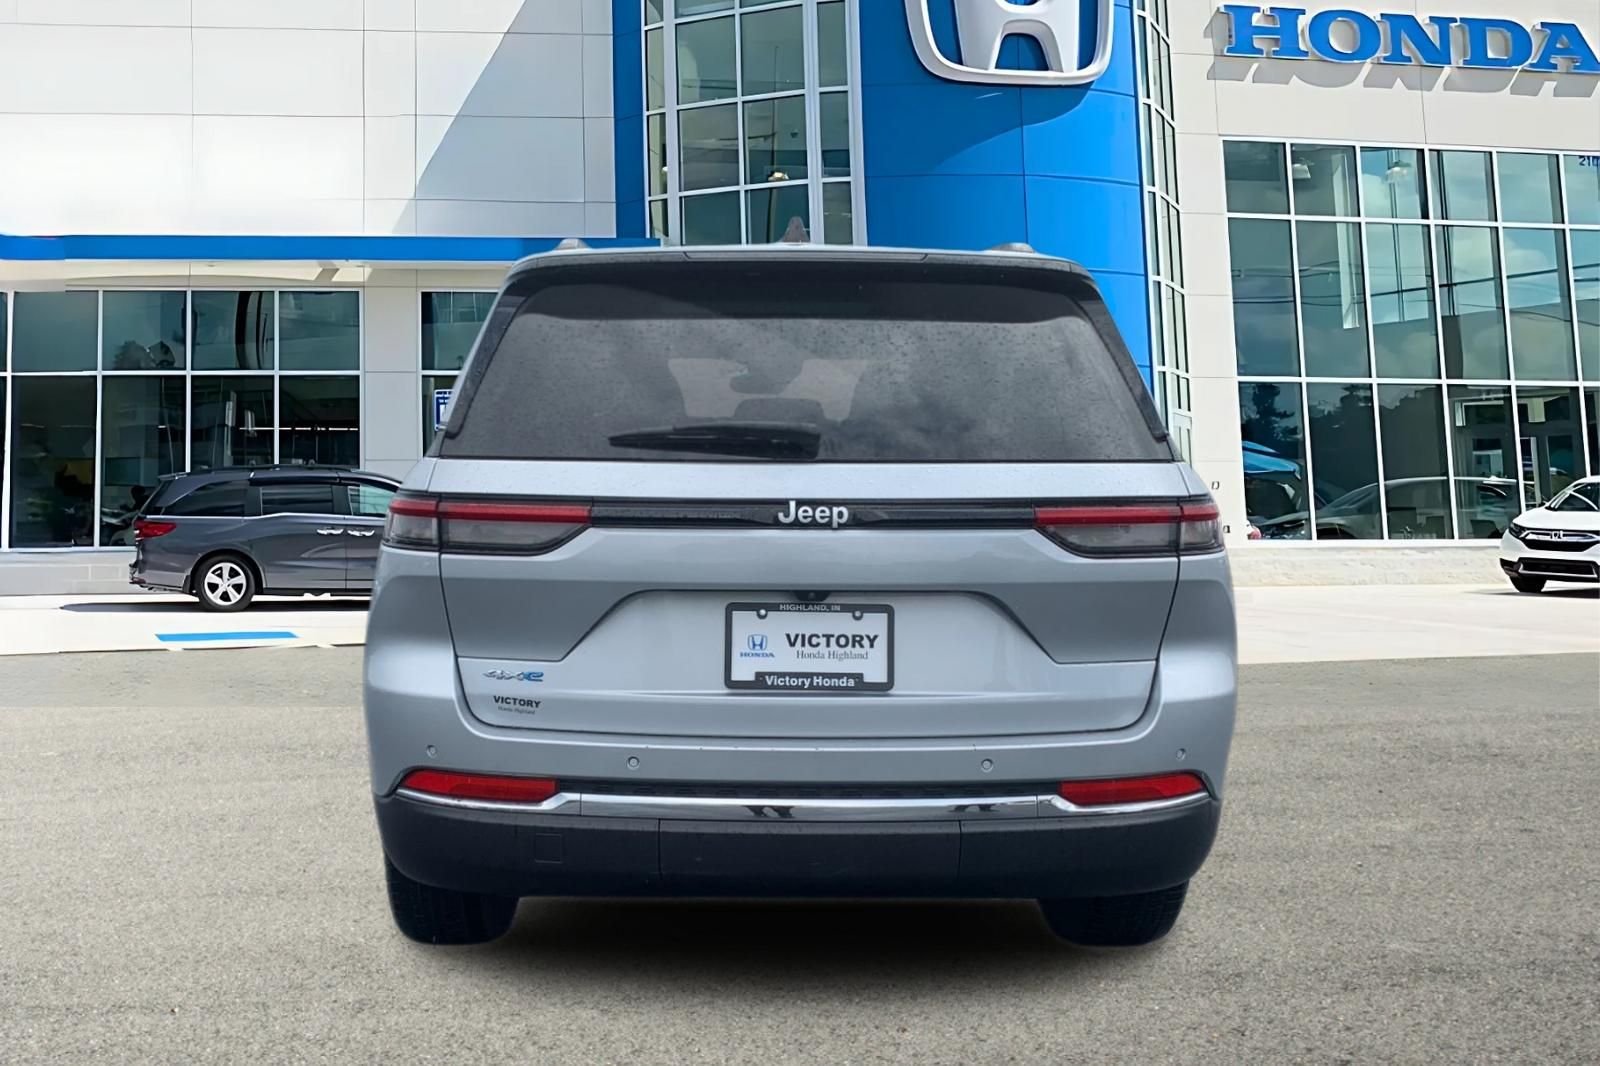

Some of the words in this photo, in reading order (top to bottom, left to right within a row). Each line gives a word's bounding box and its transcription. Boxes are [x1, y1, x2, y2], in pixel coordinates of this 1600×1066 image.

[1219, 4, 1600, 74] HONDA
[778, 500, 849, 528] Jeep
[779, 604, 829, 612] HIGHLAND,
[785, 633, 879, 649] VICTORY
[796, 650, 826, 660] Honda
[827, 651, 869, 662] Highland
[765, 676, 811, 689] Victory
[813, 676, 855, 687] Honda
[493, 695, 542, 708] VICTORY
